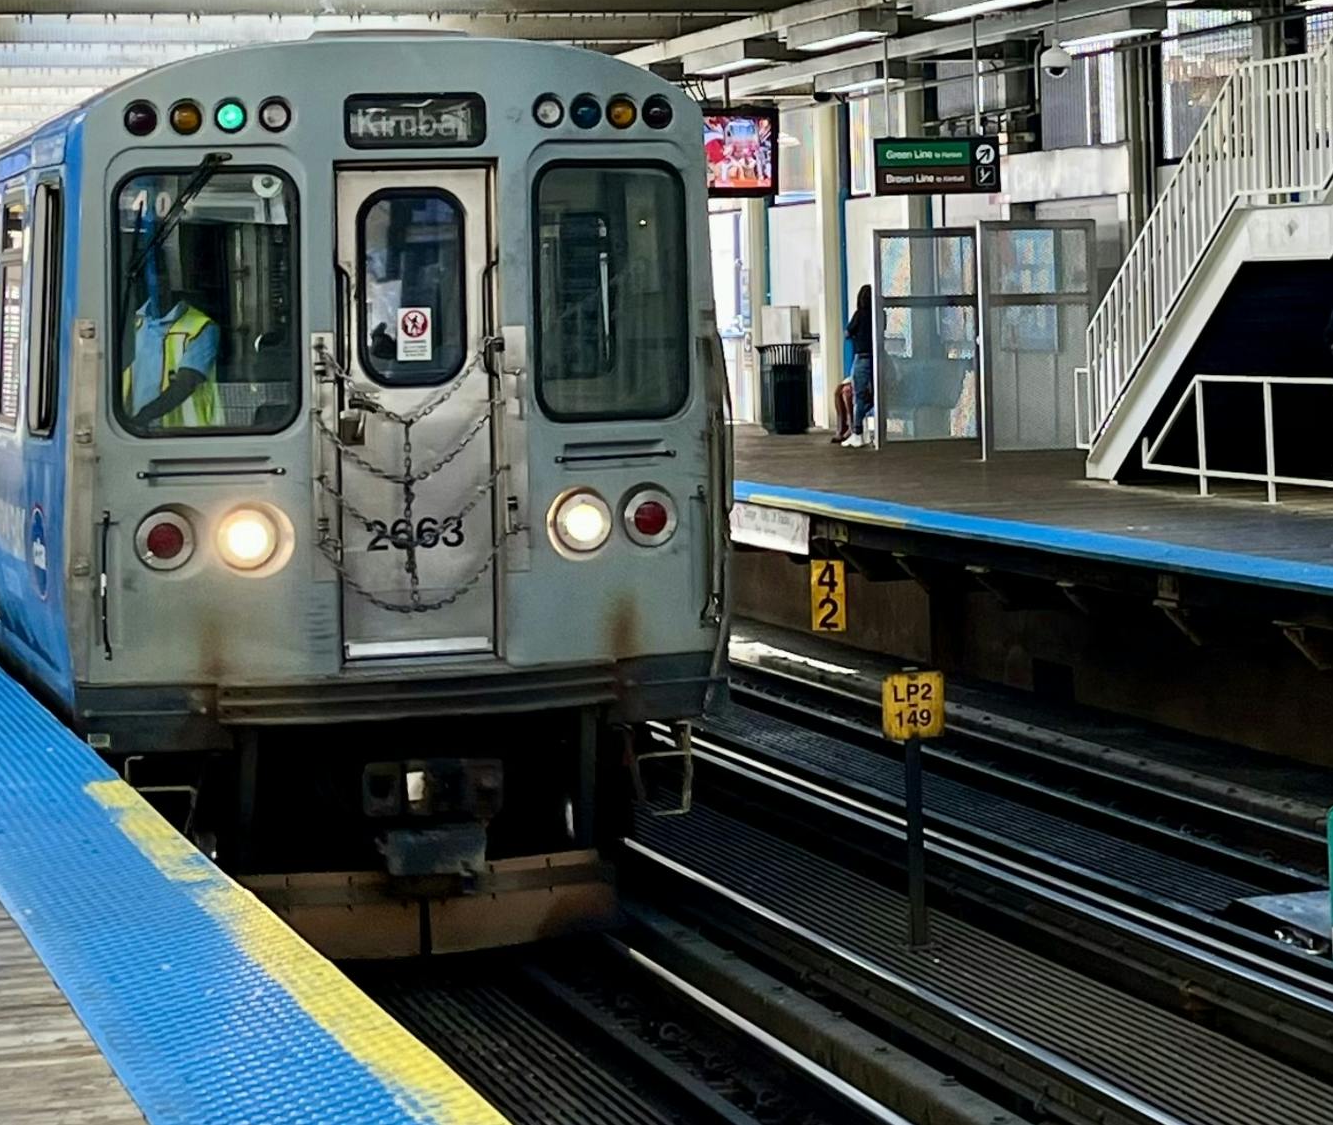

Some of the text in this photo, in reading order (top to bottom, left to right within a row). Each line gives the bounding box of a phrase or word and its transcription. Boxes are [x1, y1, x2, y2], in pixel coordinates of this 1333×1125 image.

[886, 150, 913, 159] Green
[915, 150, 932, 158] Line
[916, 174, 934, 183] Line
[367, 516, 465, 552] 2663
[817, 561, 839, 594] 4
[818, 597, 839, 629] 2
[893, 682, 933, 703] LP2
[894, 708, 932, 728] 149
